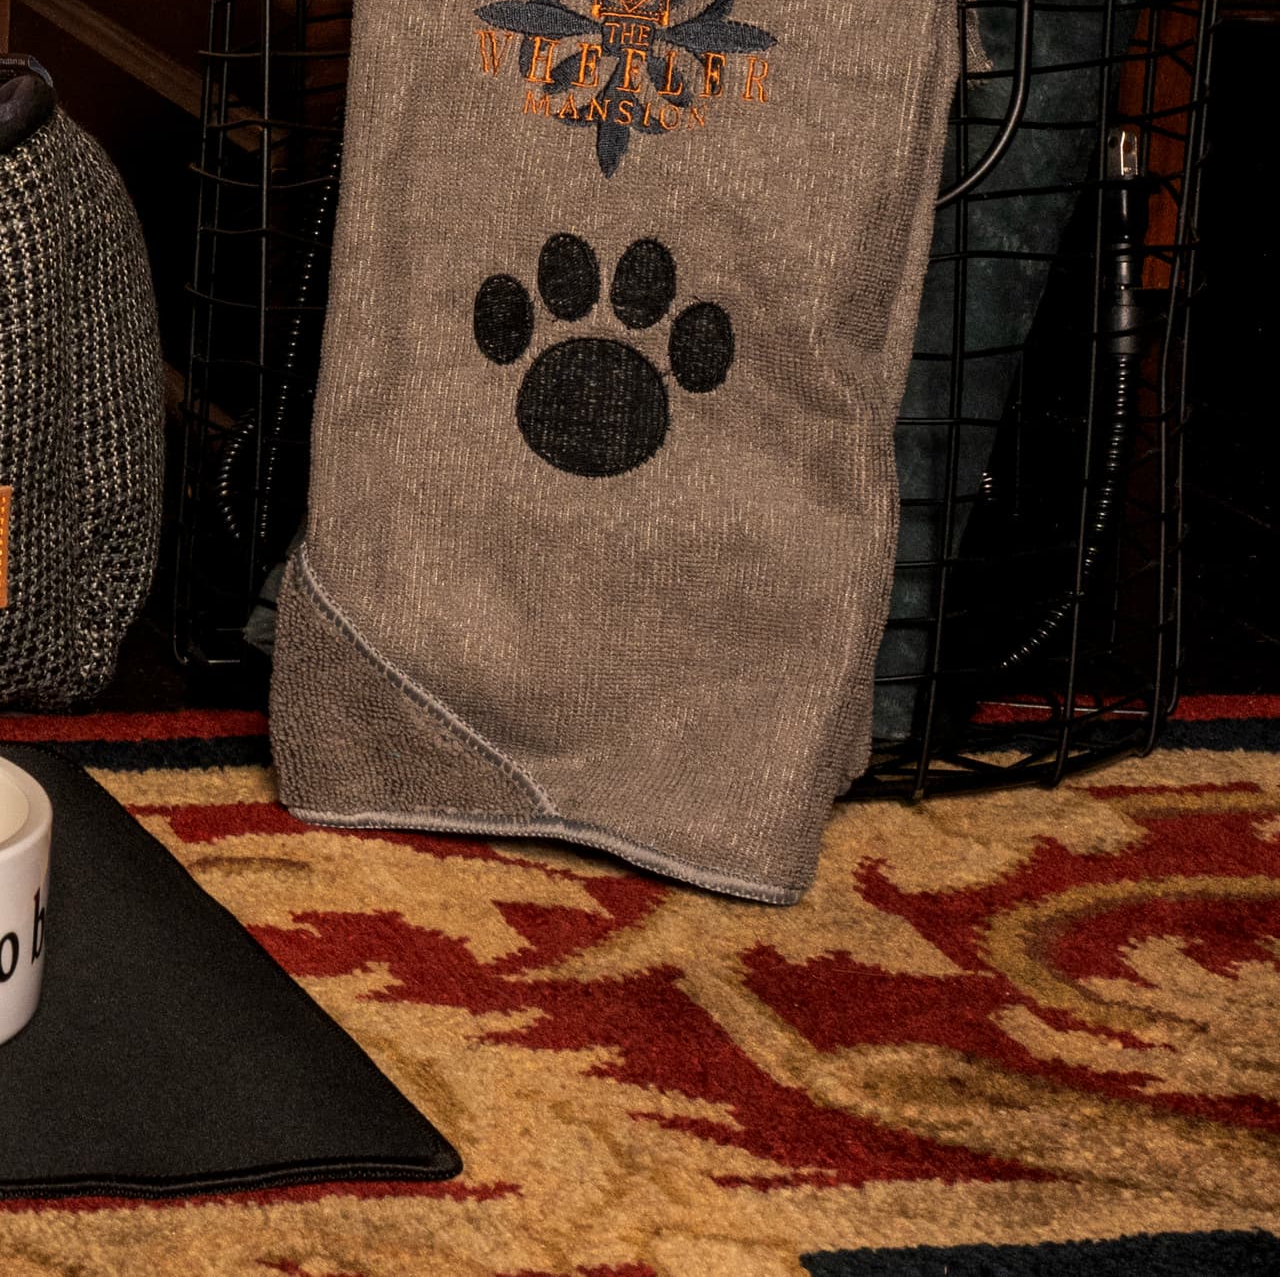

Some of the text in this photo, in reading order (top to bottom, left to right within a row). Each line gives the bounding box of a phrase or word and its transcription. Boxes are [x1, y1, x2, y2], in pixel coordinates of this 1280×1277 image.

[603, 22, 653, 47] THE
[473, 29, 770, 103] WHEELER
[522, 88, 709, 131] MANSION
